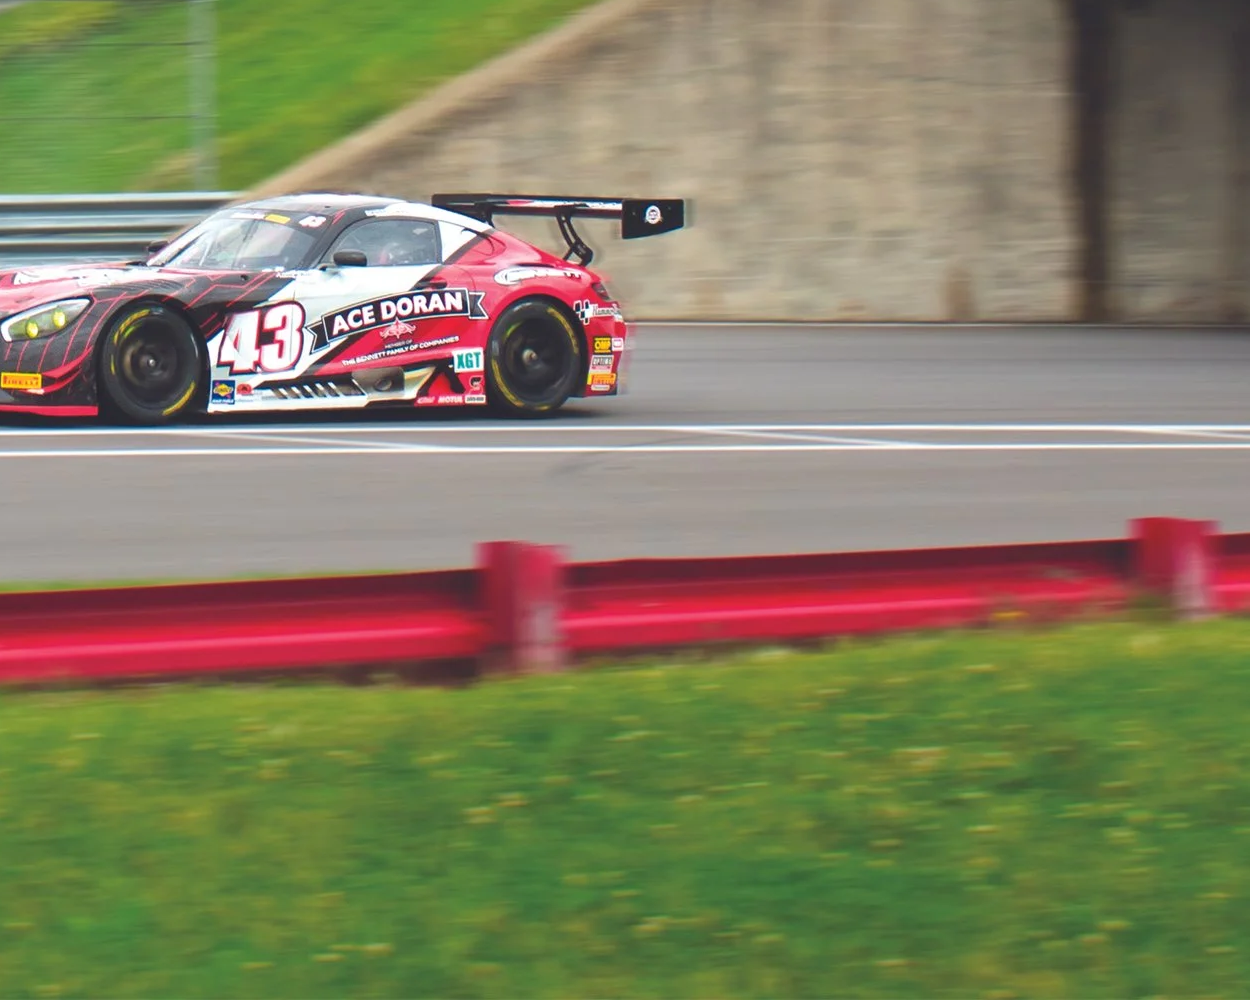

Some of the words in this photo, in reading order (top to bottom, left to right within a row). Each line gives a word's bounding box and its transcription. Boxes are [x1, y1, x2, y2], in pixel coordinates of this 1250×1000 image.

[332, 304, 376, 336] ACE
[379, 291, 463, 321] DORAN
[217, 301, 305, 376] 43
[355, 351, 387, 364] BENNETT
[386, 346, 410, 357] FAMILY
[409, 343, 418, 351] OF
[419, 336, 460, 349] COMPANIES
[594, 340, 611, 350] OMP
[456, 351, 481, 369] XGT
